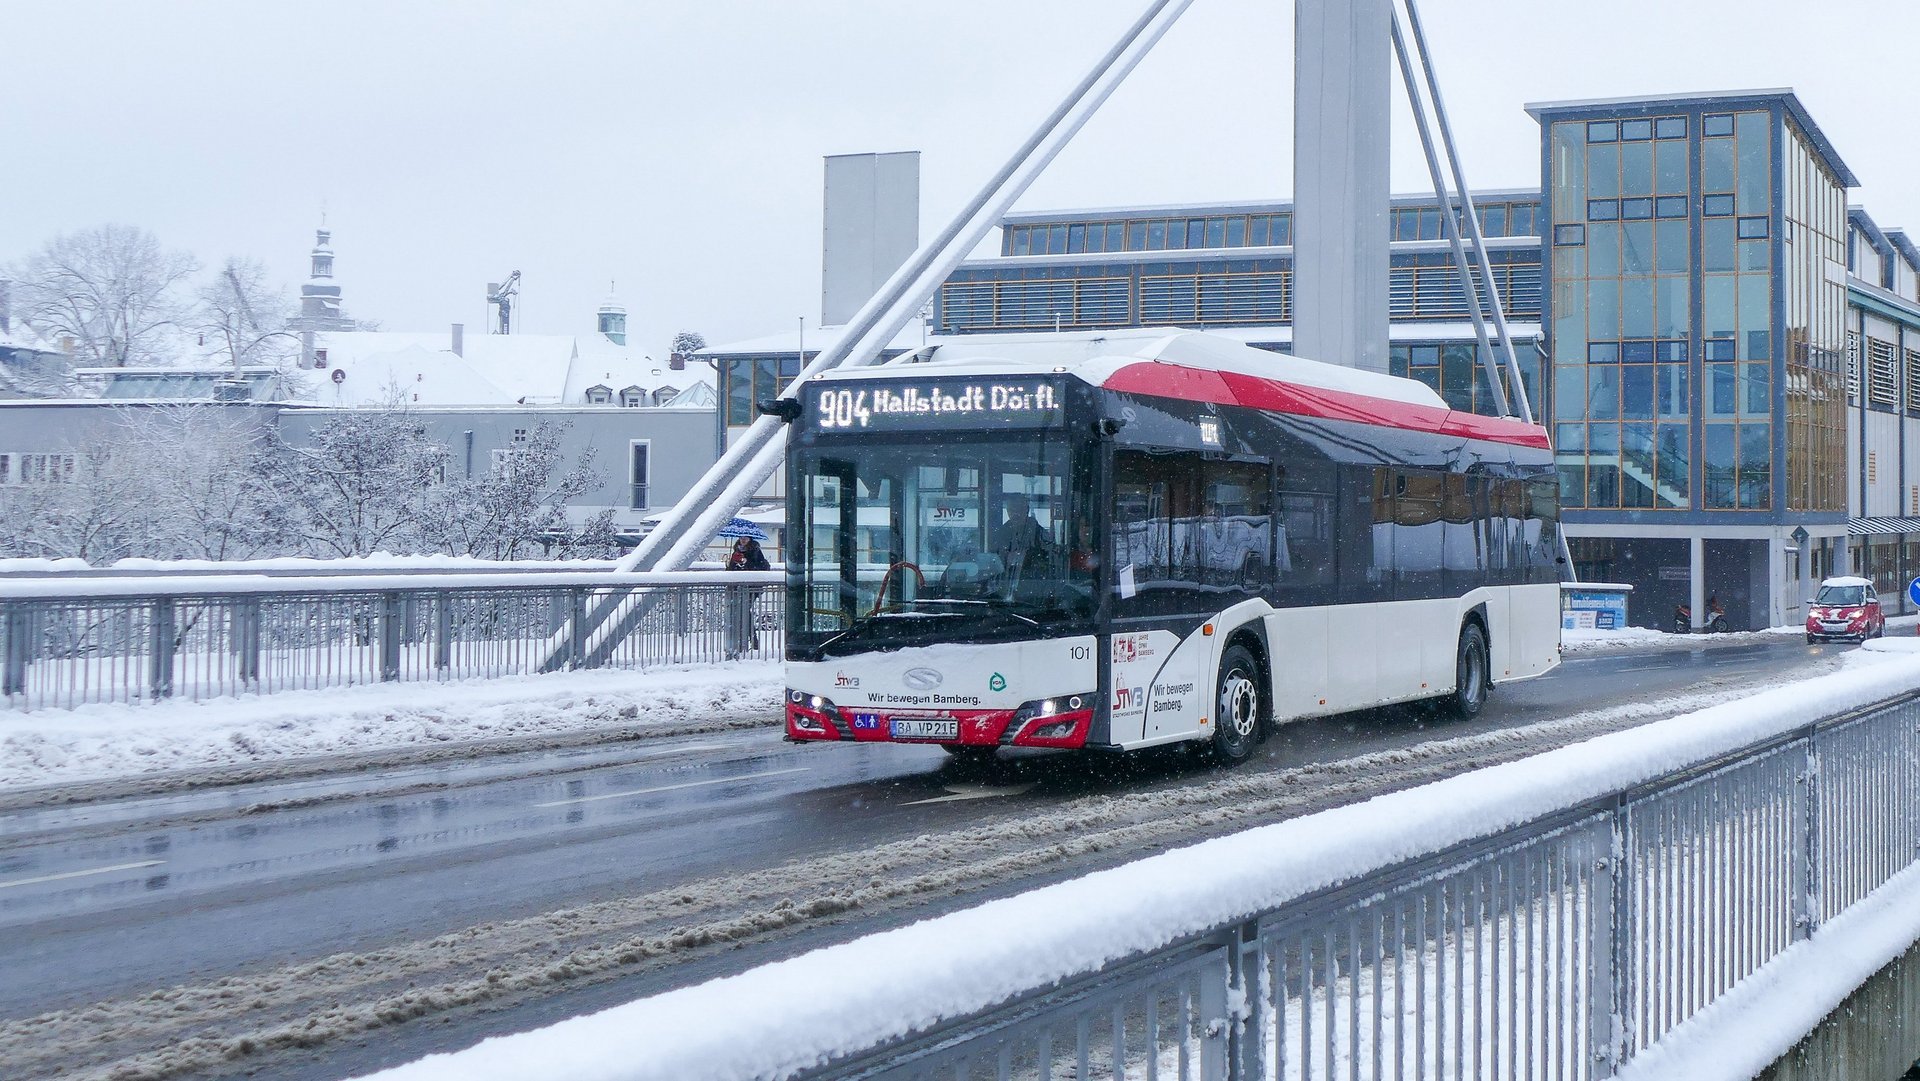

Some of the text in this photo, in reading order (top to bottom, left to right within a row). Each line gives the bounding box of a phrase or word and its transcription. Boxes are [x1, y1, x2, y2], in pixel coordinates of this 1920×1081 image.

[819, 384, 1060, 427] 904 Hallstadt Dörfl.
[1070, 645, 1090, 661] 101
[1153, 682, 1193, 697] Wir bewegen
[867, 693, 982, 705] Wir bewegen Bamberg.
[1153, 699, 1183, 713] Bamberg.
[897, 722, 911, 735] BA
